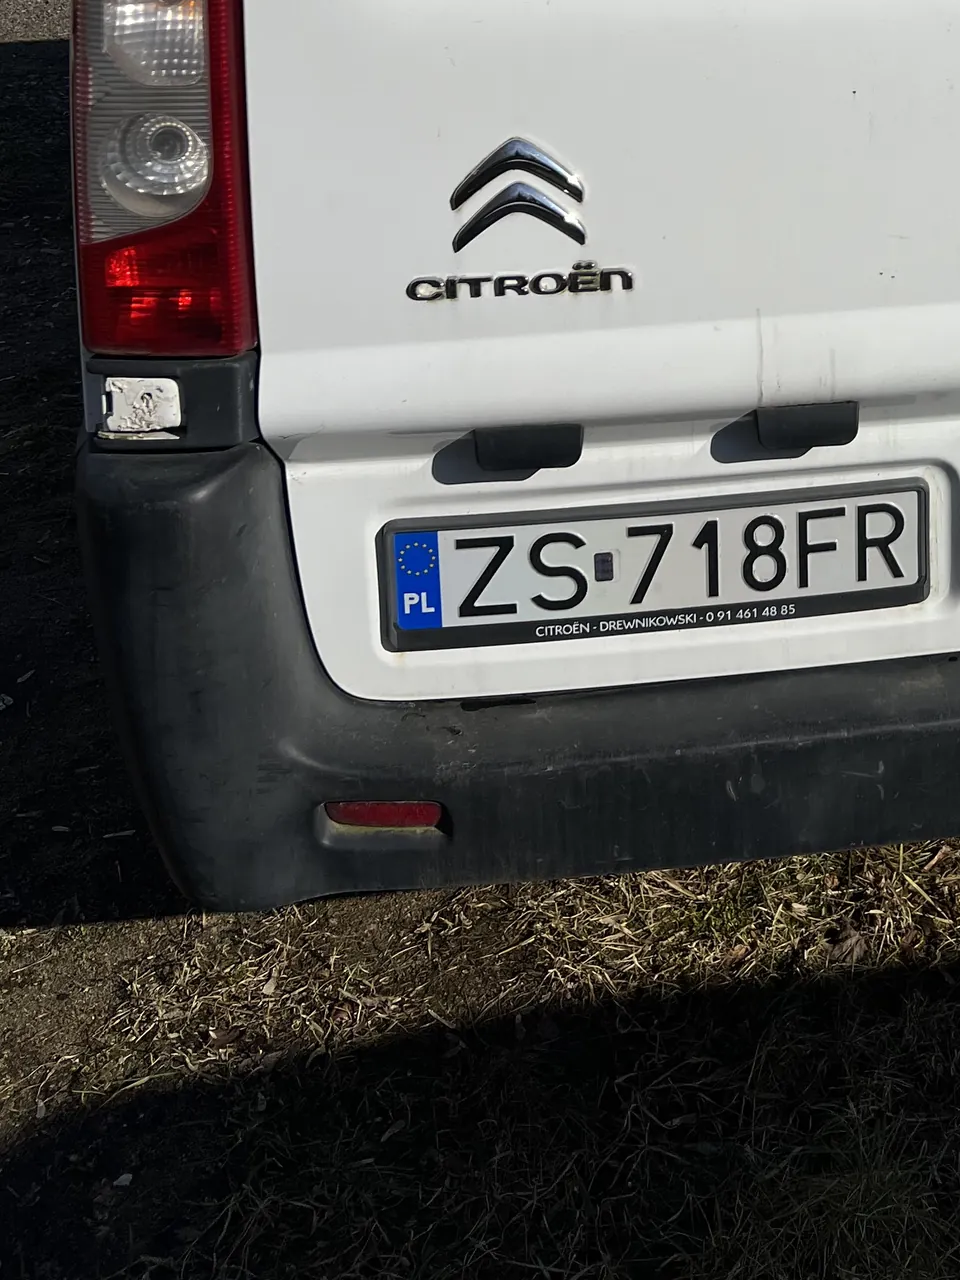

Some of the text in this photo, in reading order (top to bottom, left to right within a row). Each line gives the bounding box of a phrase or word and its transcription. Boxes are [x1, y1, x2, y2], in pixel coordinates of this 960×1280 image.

[454, 503, 906, 617] ZS 718FR
[404, 592, 435, 615] PL
[535, 621, 590, 637] CITROËN
[600, 613, 697, 632] DREWNIKOWSKI
[706, 611, 714, 622] 0
[717, 609, 731, 621] 91
[735, 607, 757, 619] 461
[761, 605, 777, 617] 48
[780, 604, 796, 615] 85
